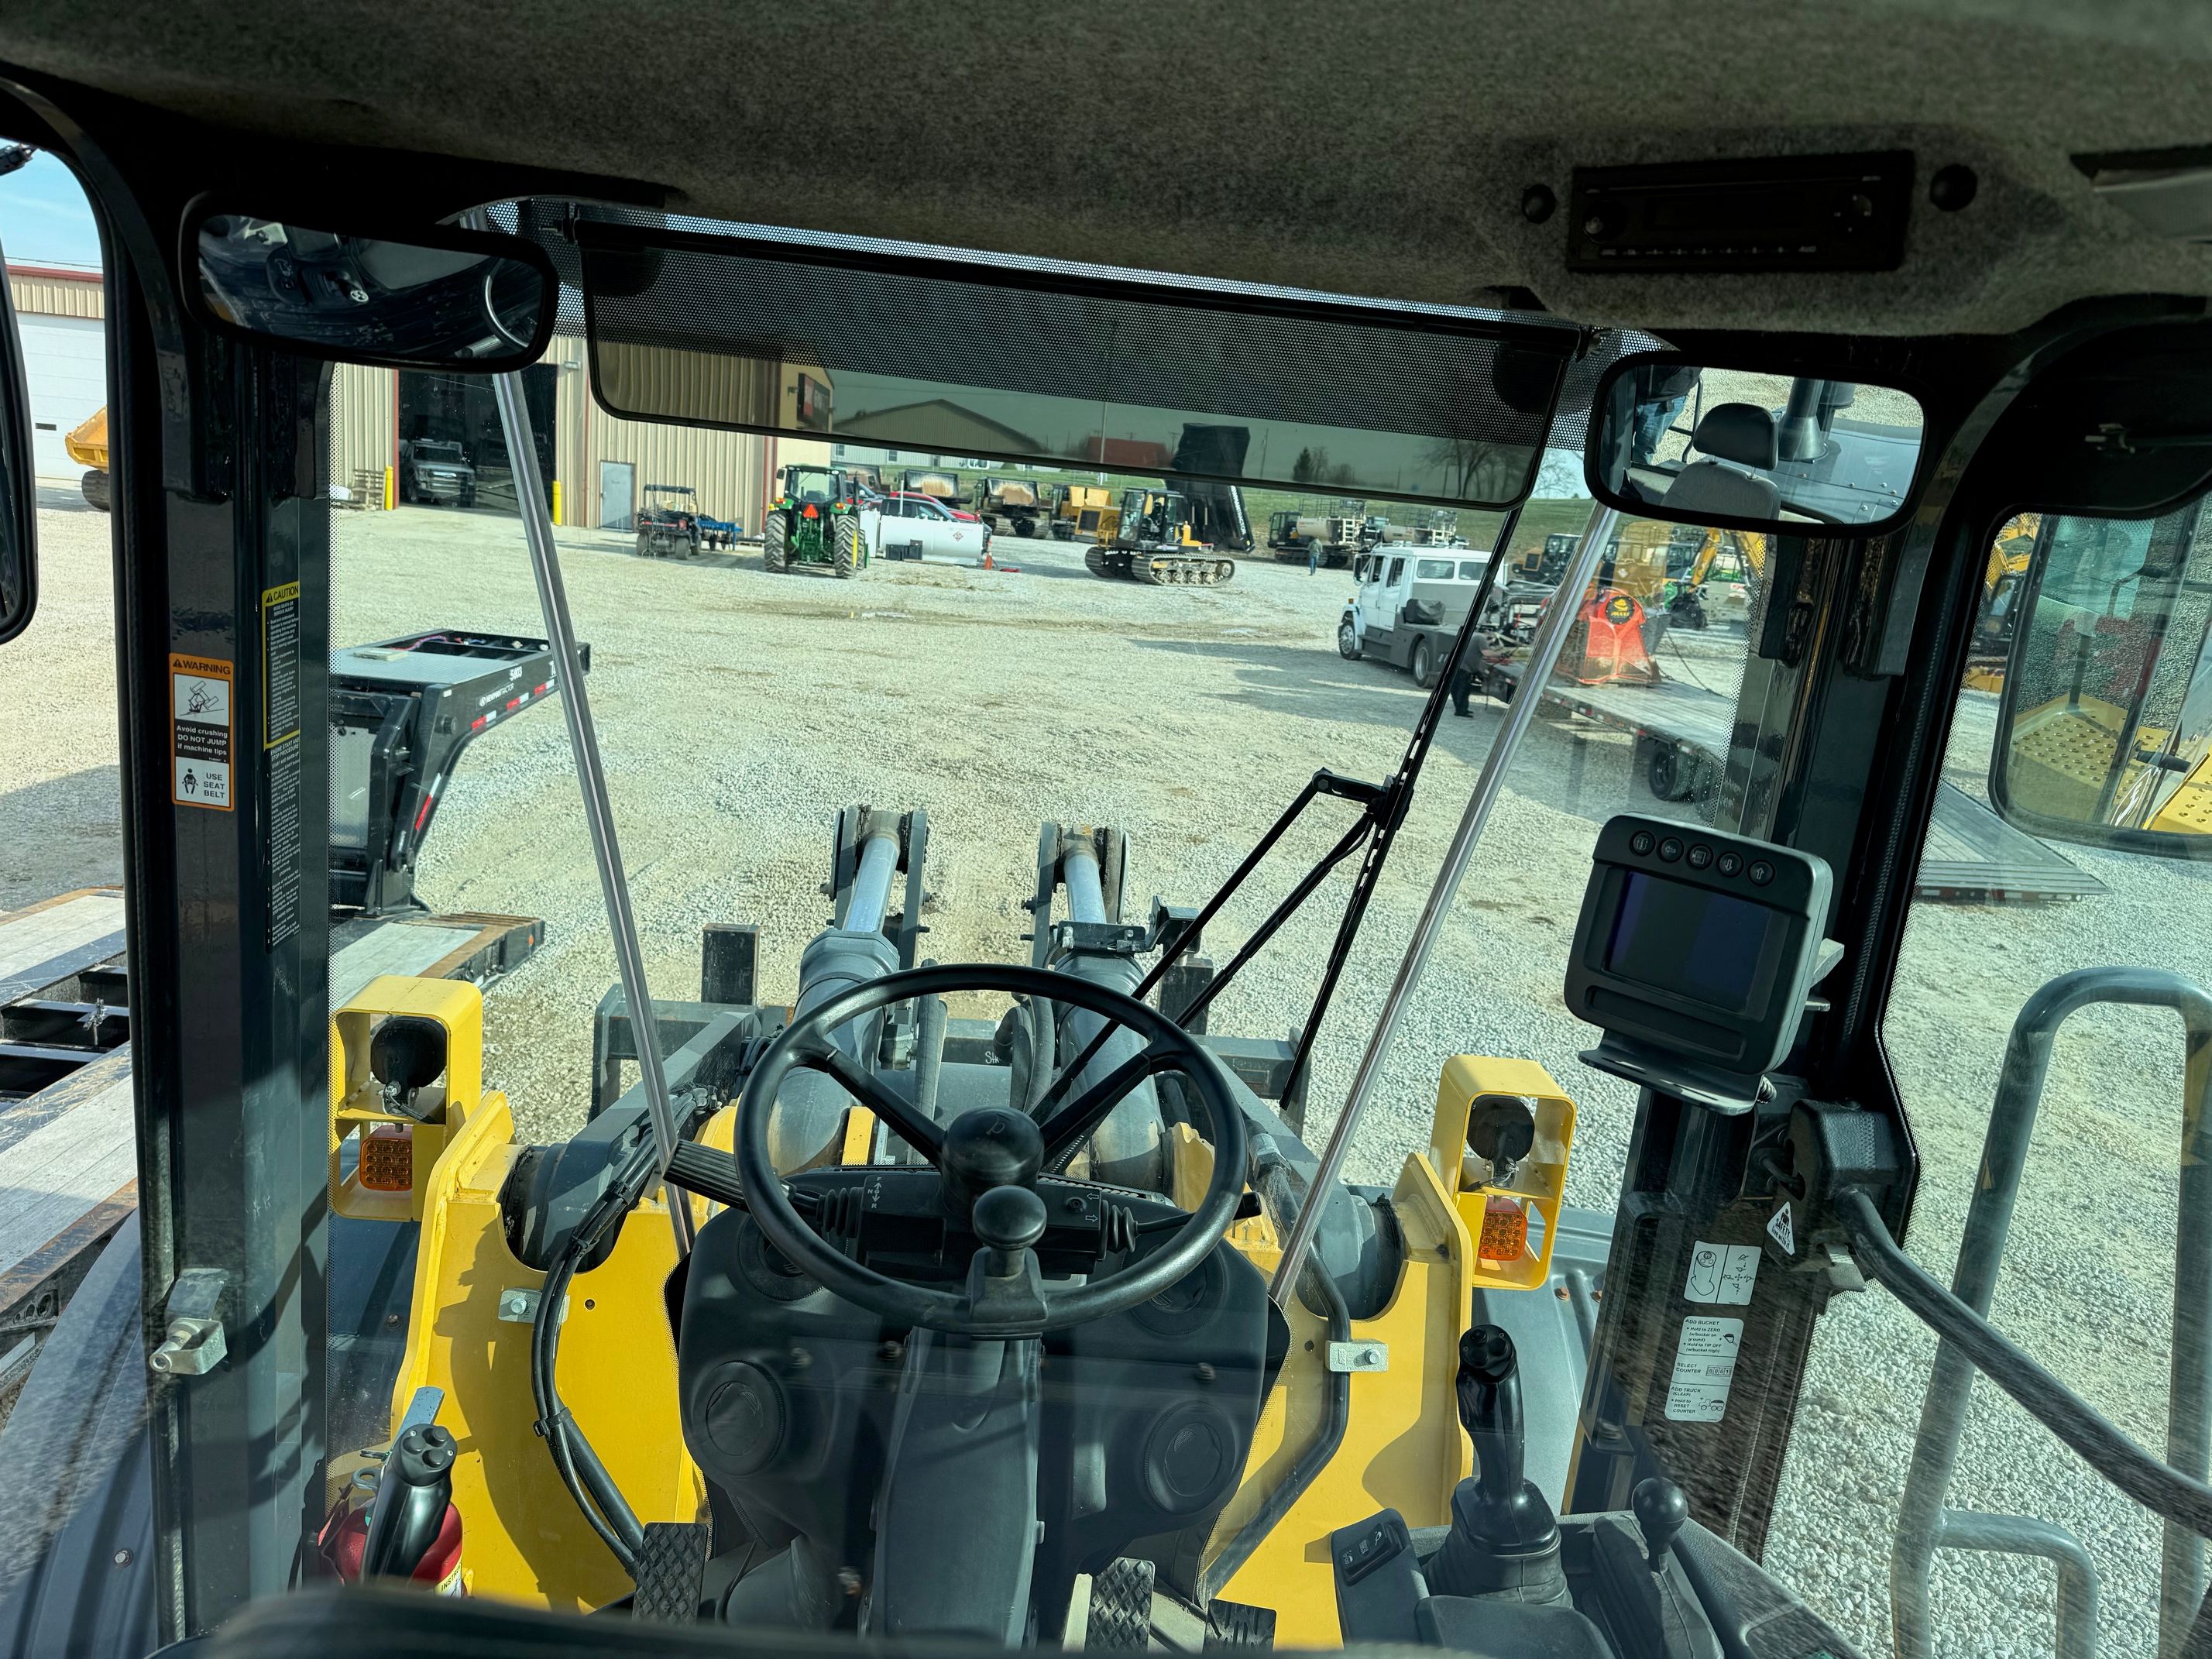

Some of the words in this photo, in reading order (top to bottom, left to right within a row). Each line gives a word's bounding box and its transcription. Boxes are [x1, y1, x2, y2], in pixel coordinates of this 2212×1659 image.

[273, 585, 298, 601] CAUTION
[182, 659, 231, 675] WARNING
[198, 729, 228, 739] crushing
[184, 744, 213, 754] machine
[206, 773, 222, 781] USE
[203, 781, 225, 790] SEAT
[204, 790, 225, 798] BELT
[1775, 1218, 1790, 1238] SAFETY
[1778, 1235, 1786, 1246] with
[1786, 1241, 1790, 1250] it
